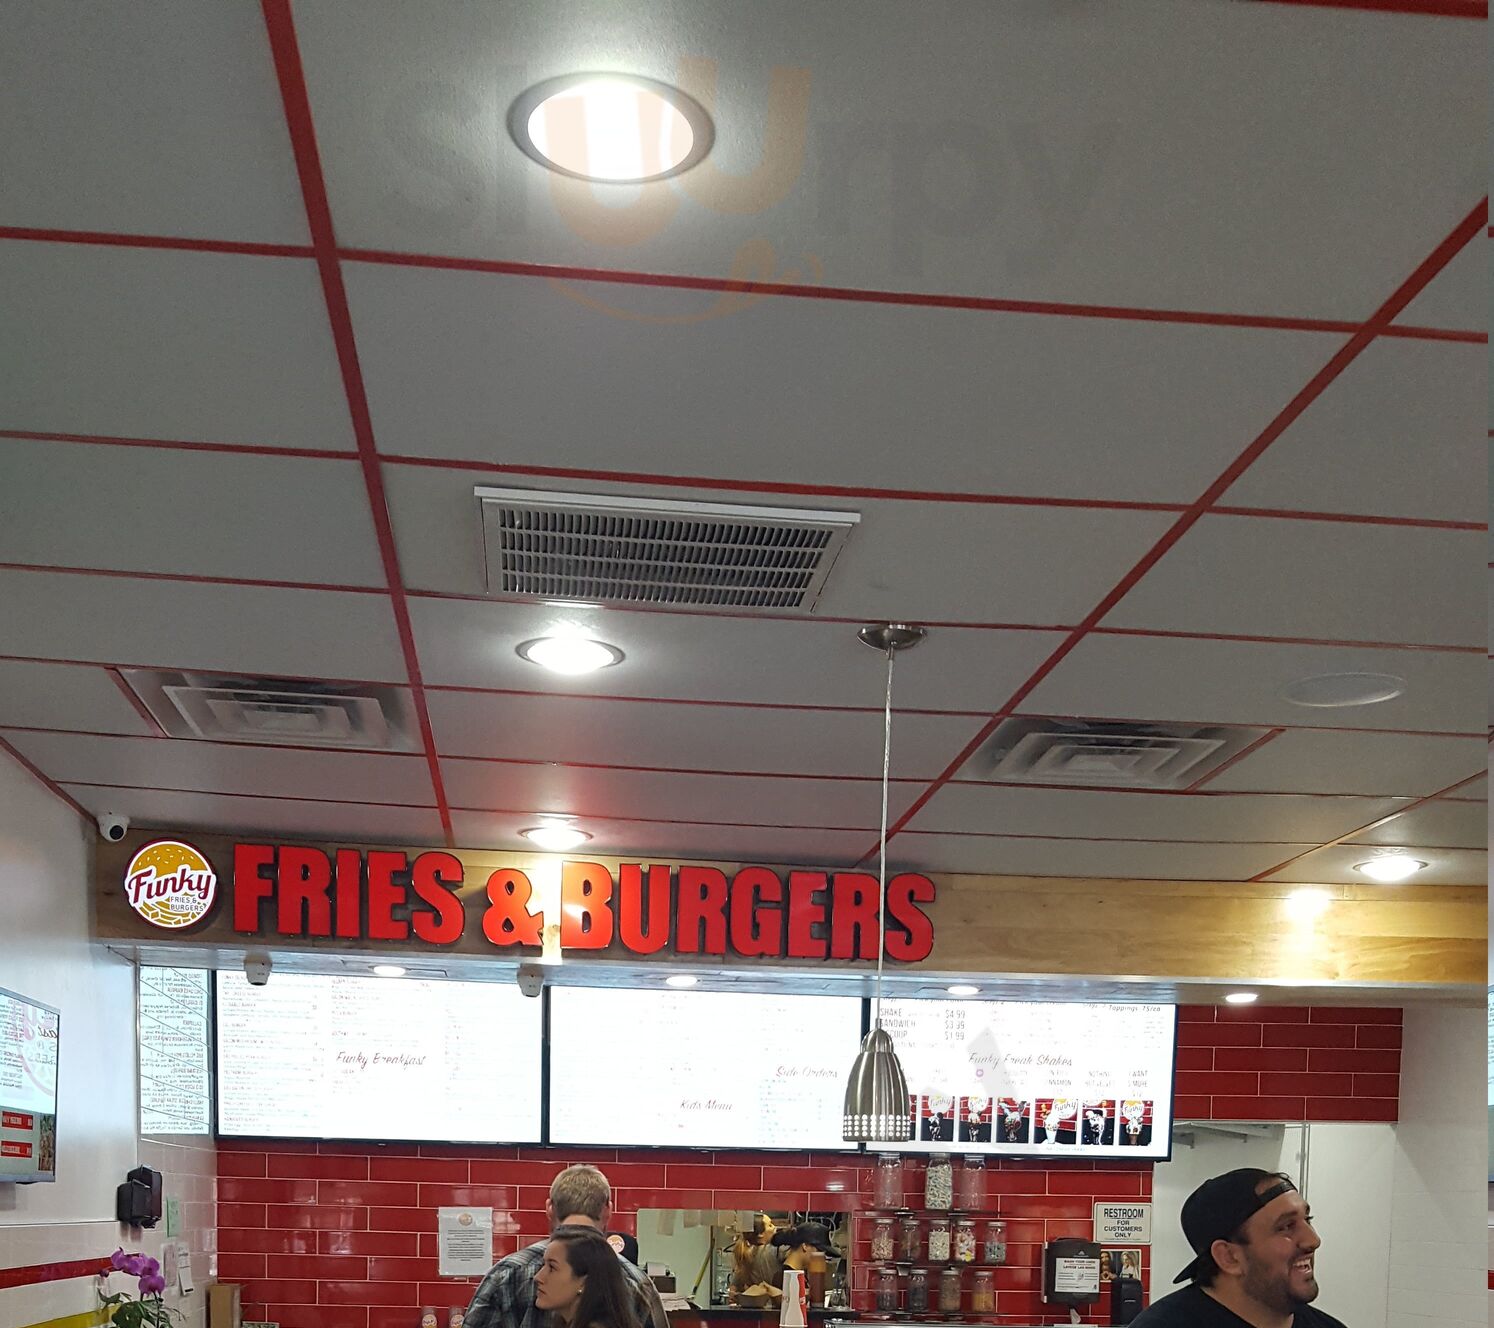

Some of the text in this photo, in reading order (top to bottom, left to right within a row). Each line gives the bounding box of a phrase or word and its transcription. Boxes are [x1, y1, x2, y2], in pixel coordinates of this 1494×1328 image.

[128, 867, 212, 904] Funky
[170, 904, 204, 912] BURGERS
[232, 842, 937, 963] FRIES & BURGERS
[880, 1008, 902, 1017] SHAKE
[880, 1018, 916, 1028] SANDWICH
[336, 1051, 368, 1070] Funky
[968, 1052, 1000, 1071] Funky
[1036, 1054, 1072, 1066] Shakes
[1104, 1208, 1144, 1218] RESTROOM
